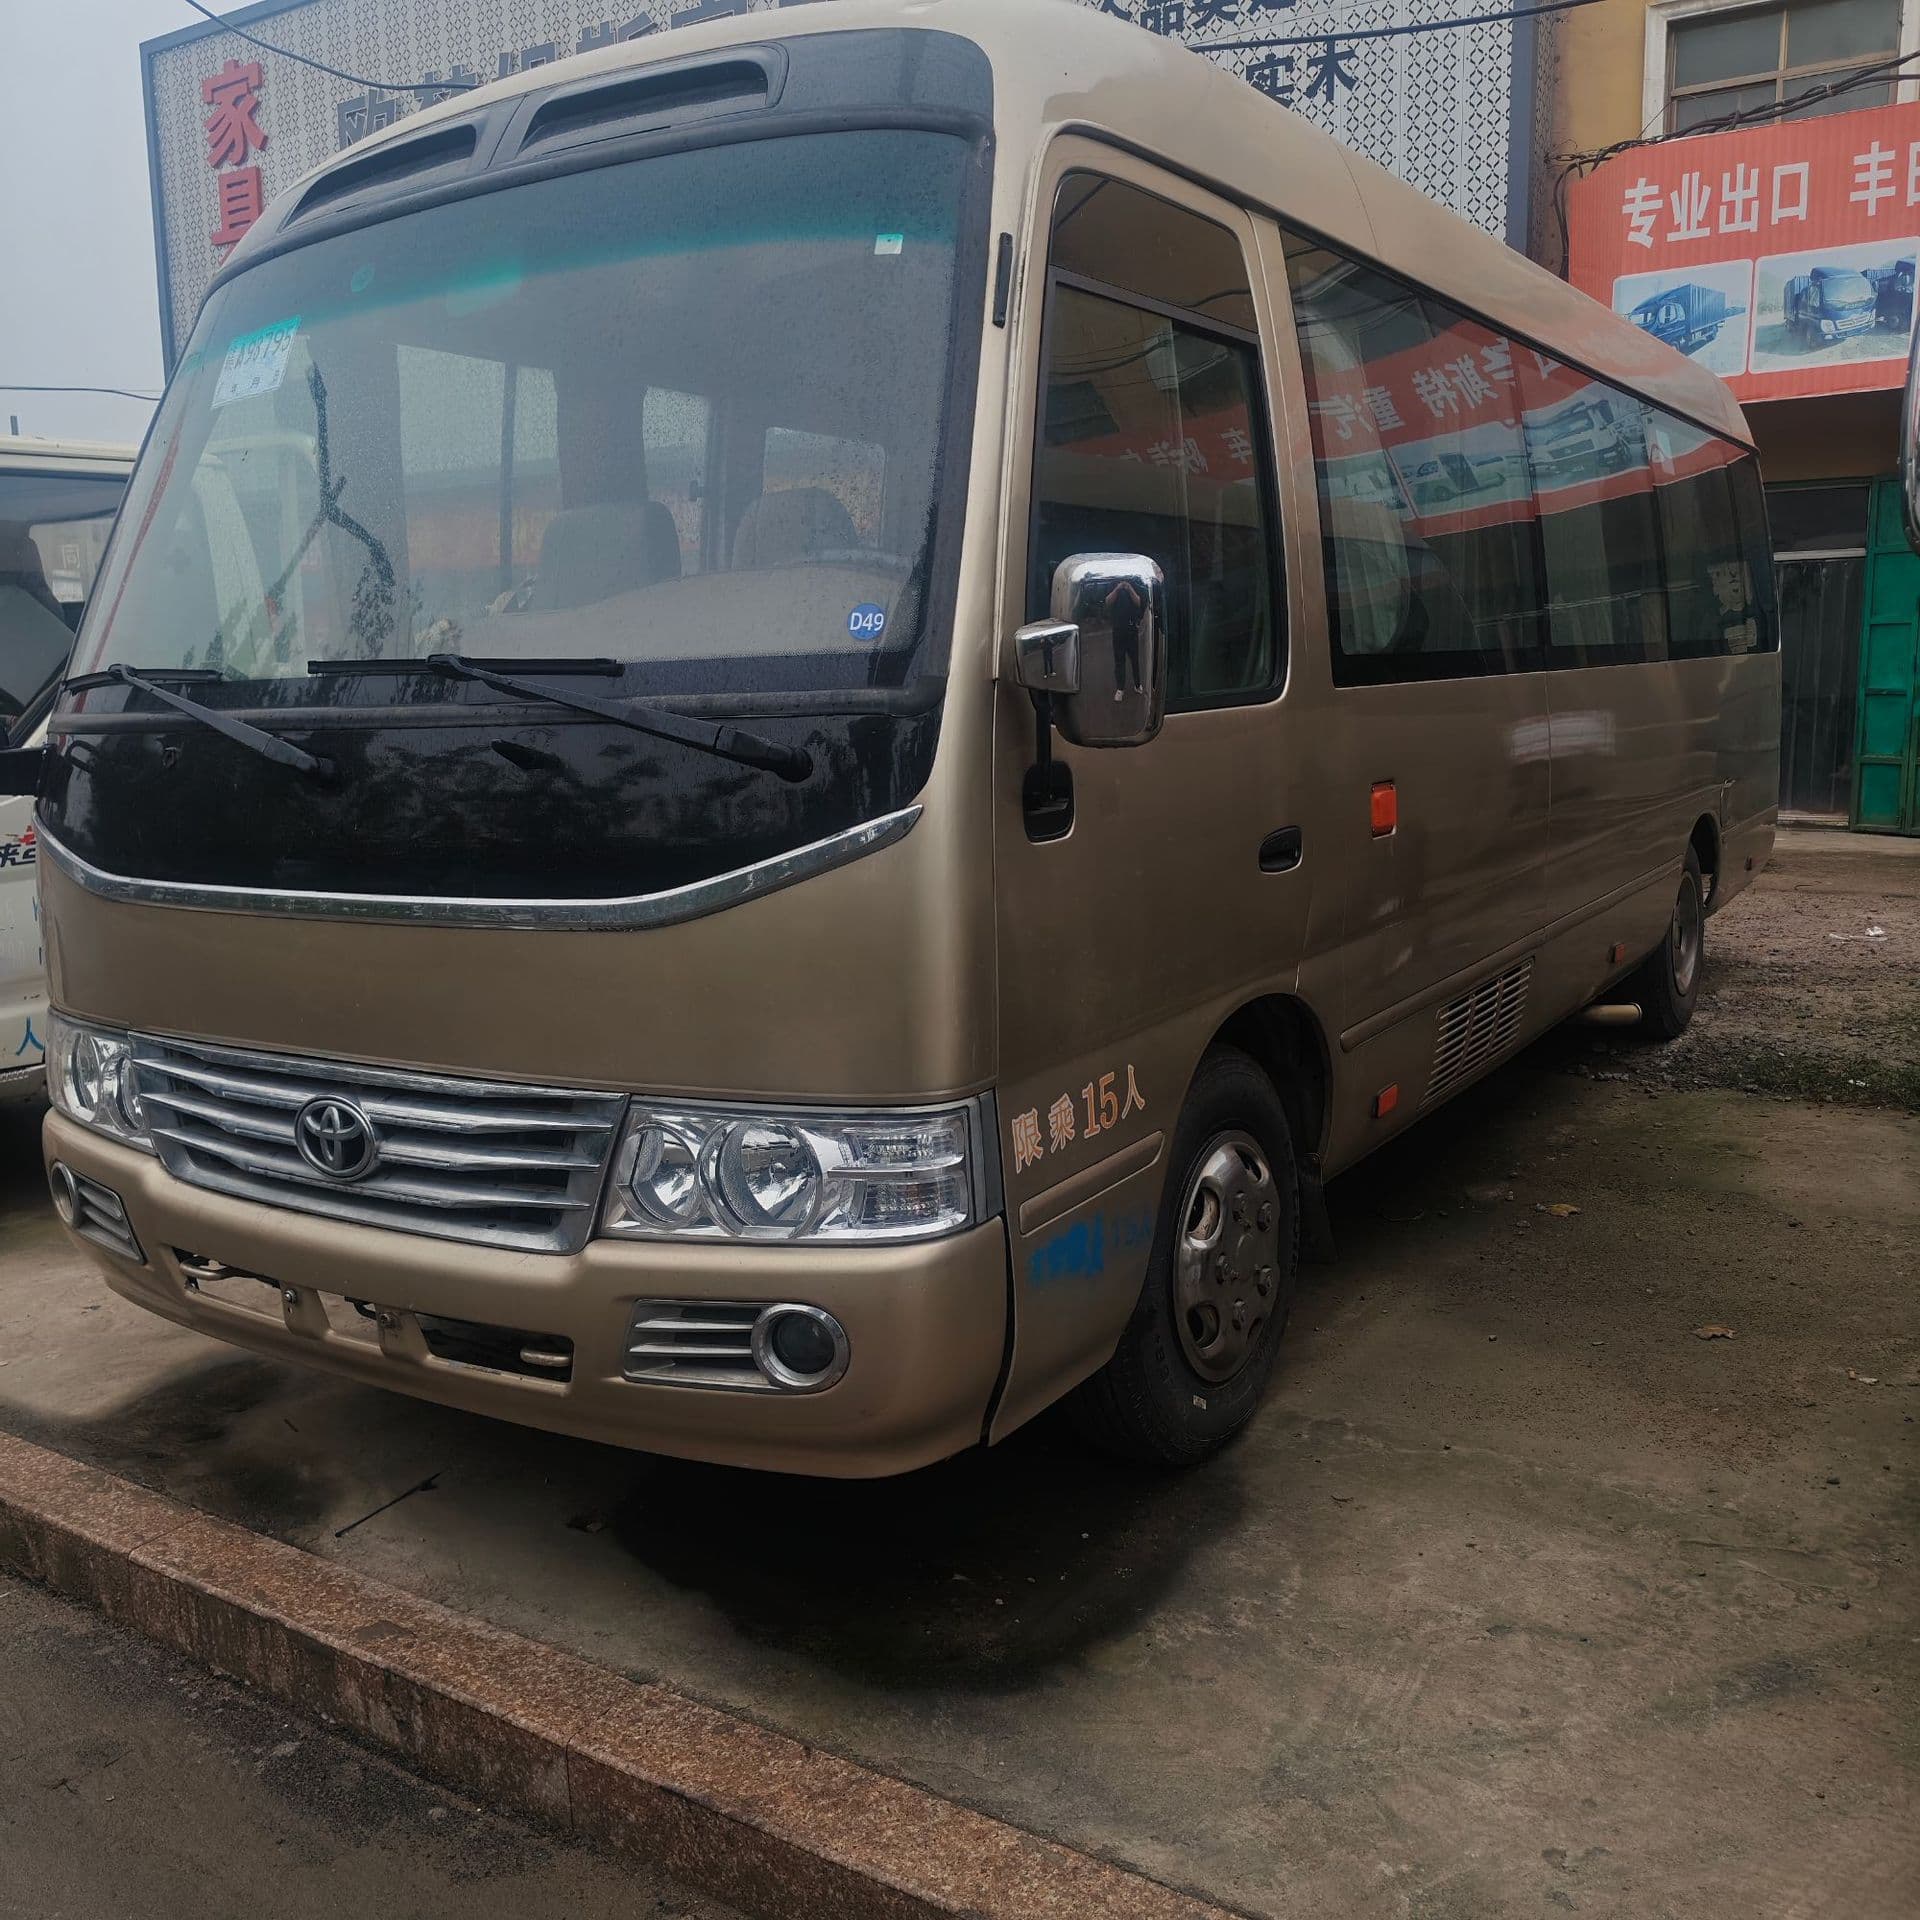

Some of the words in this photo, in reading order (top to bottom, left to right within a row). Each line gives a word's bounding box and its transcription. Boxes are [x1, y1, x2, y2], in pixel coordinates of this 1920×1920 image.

[1246, 40, 1357, 109] 实木
[202, 59, 268, 266] 家具
[1622, 162, 1810, 249] 专业出口
[849, 612, 885, 632] D49
